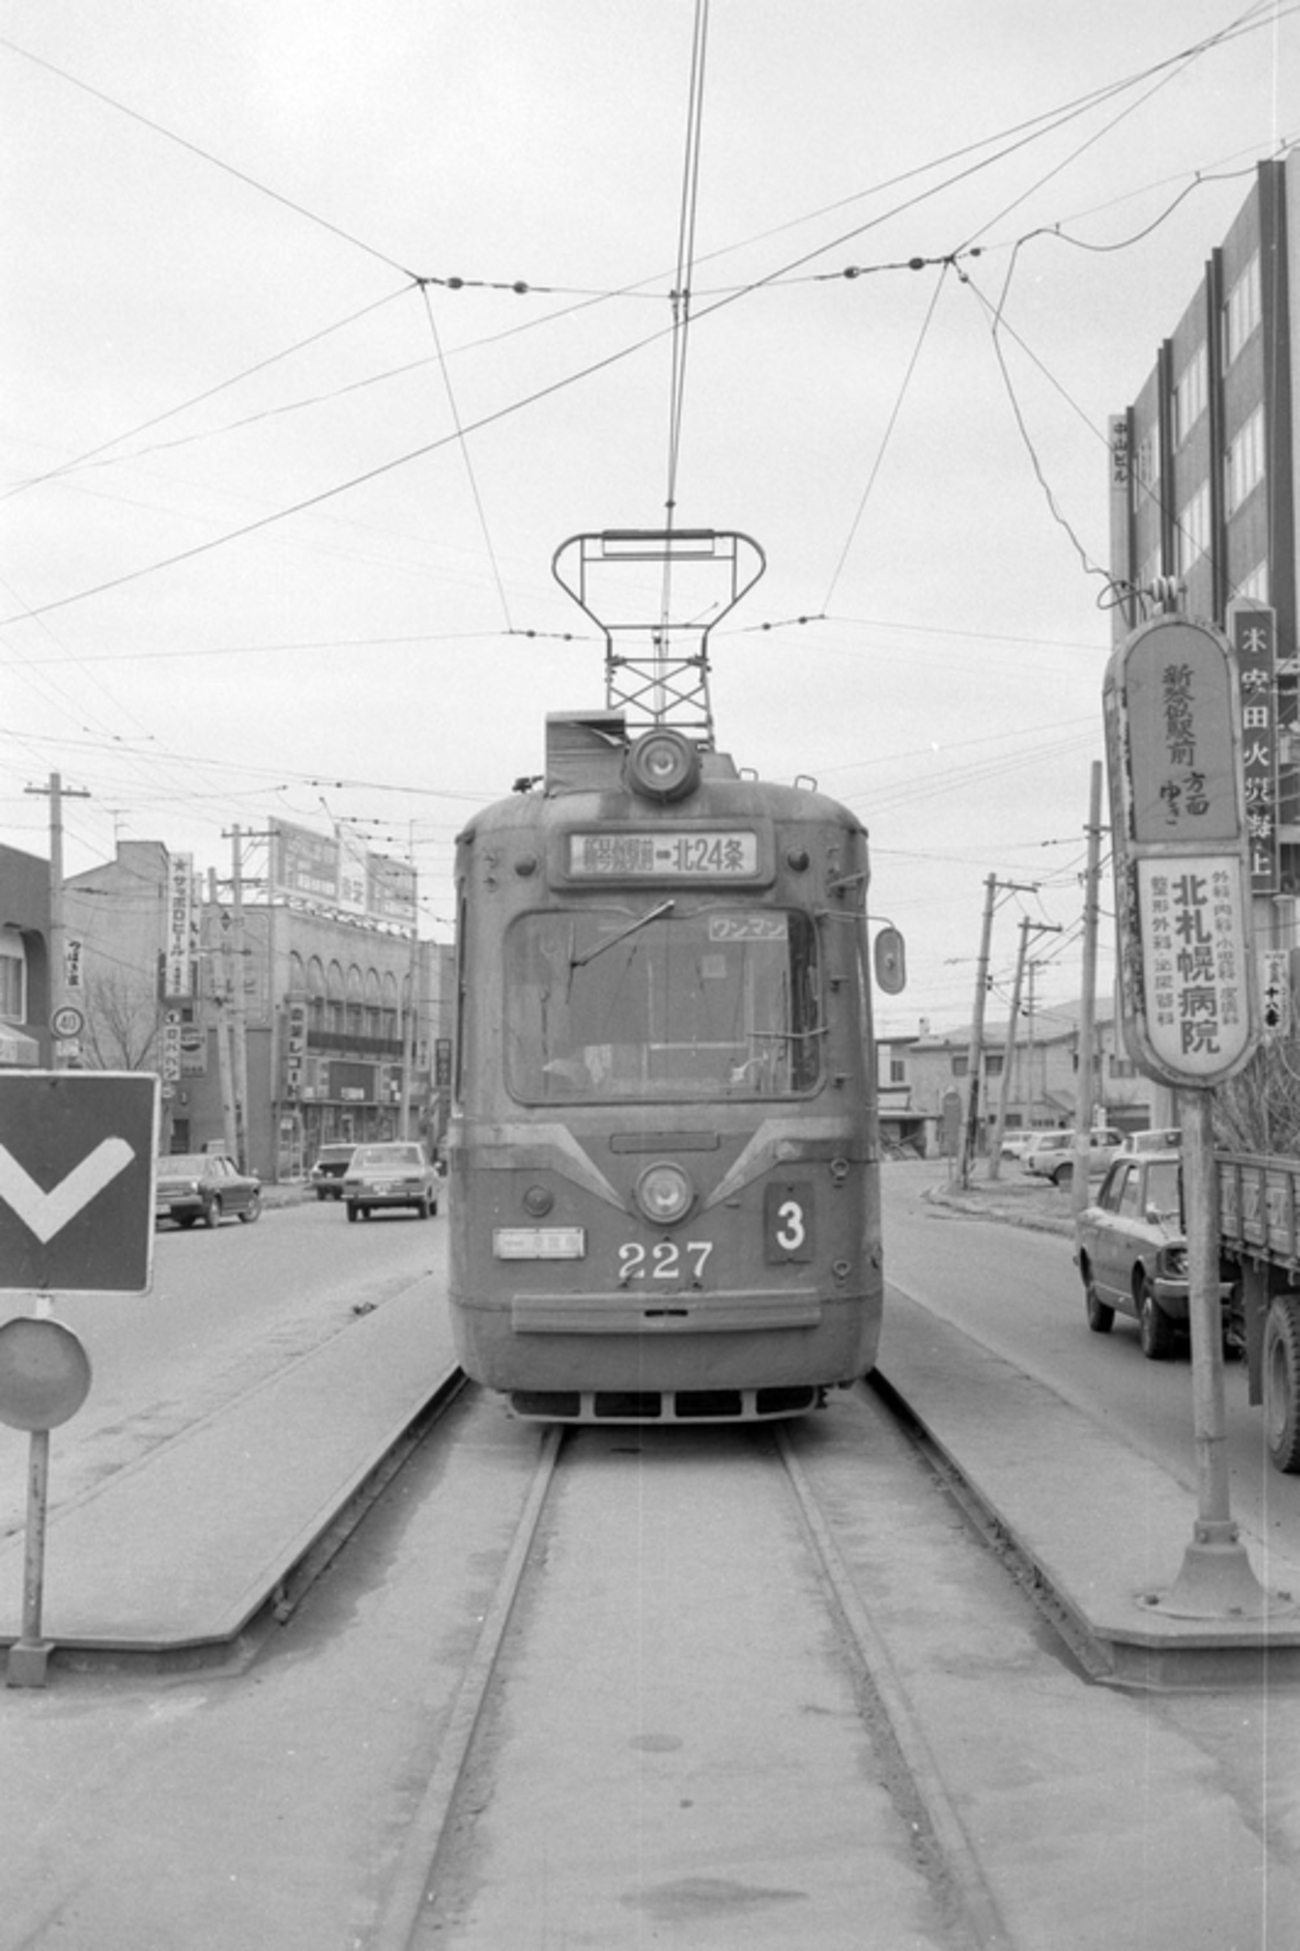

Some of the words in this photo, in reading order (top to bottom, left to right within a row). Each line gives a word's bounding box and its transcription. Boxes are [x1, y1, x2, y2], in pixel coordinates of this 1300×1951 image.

[1161, 663, 1196, 767] 新琴似駅前
[1183, 771, 1210, 817] 方面
[713, 918, 785, 938] ワンマン
[1171, 874, 1221, 1055] 北札幌病院
[58, 1013, 77, 1032] 40
[776, 1201, 806, 1251] 3
[618, 1241, 714, 1280] 227
